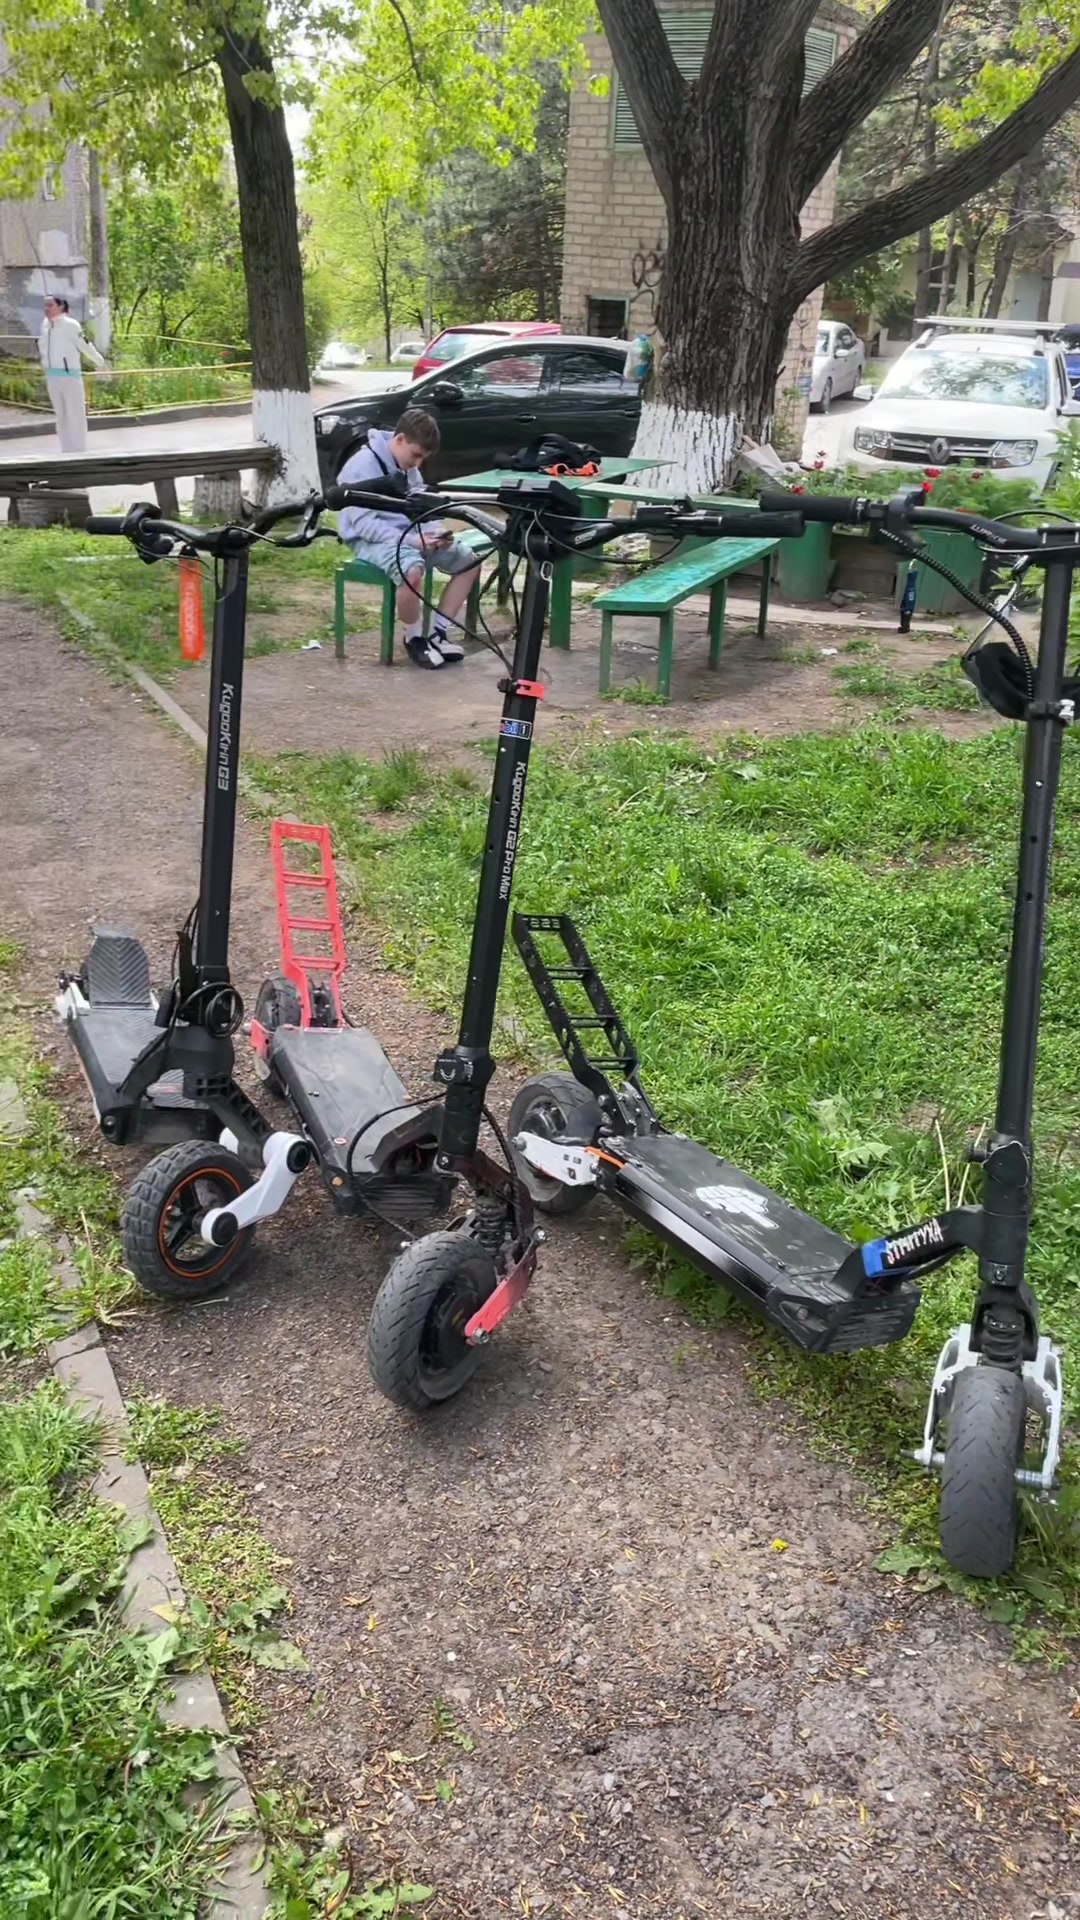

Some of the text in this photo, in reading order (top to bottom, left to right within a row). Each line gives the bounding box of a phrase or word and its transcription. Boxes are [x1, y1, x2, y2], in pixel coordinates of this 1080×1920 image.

[499, 761, 526, 900] KugooKirin G2 Pro Max
